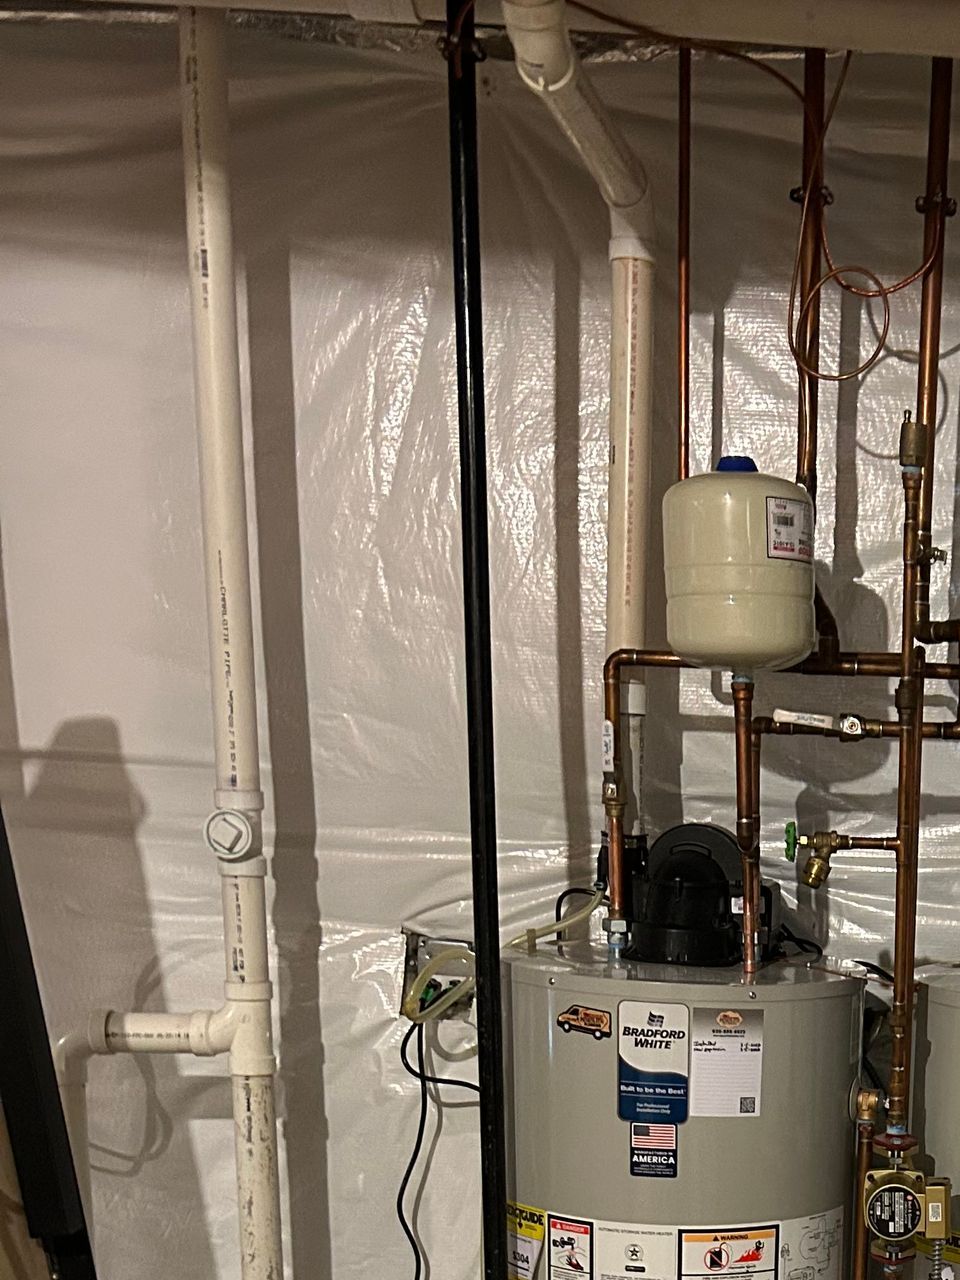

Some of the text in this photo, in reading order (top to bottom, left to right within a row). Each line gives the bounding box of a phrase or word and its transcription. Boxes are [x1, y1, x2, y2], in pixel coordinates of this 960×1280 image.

[220, 586, 229, 645] CHARLOTTE
[622, 1026, 686, 1040] BRADFORD
[634, 1038, 672, 1050] WHITE
[620, 1084, 636, 1093] Built
[636, 1085, 644, 1093] to
[644, 1086, 654, 1094] be
[668, 1087, 684, 1095] Best
[632, 1155, 676, 1165] AMERICA
[562, 1224, 585, 1233] DANGER
[512, 1250, 530, 1265] $304
